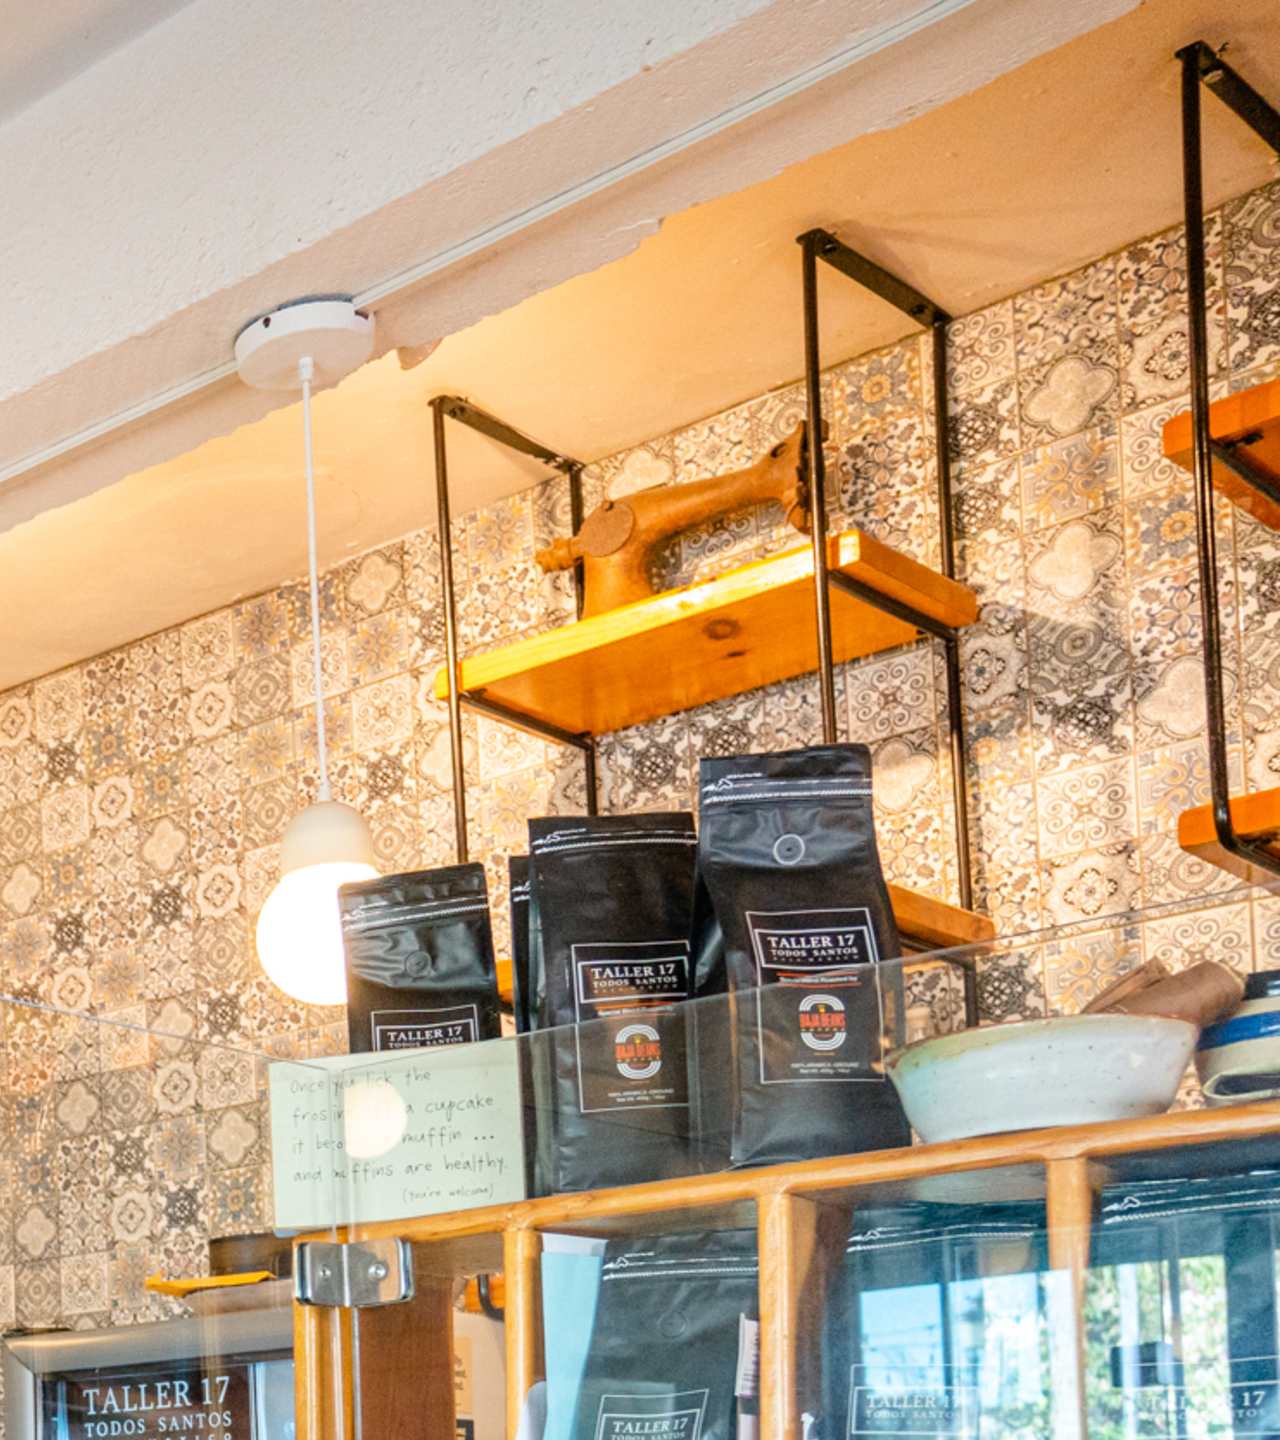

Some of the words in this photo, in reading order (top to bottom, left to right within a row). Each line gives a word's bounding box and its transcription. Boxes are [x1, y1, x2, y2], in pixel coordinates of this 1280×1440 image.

[767, 935, 833, 949] TALLER
[837, 933, 855, 947] 17
[771, 949, 807, 957] TODOS
[813, 946, 858, 957] SANTOS
[591, 965, 655, 979] TALLER
[659, 963, 676, 975] 17
[593, 979, 629, 989] TODOS
[635, 975, 678, 986] SANTOS
[387, 1030, 443, 1042] TALLER
[447, 1025, 462, 1037] 17
[290, 1079, 325, 1094] Once
[406, 1067, 431, 1085] the
[424, 1095, 494, 1121] cupcake
[293, 1164, 321, 1183] and
[405, 1163, 433, 1175] are
[82, 1380, 192, 1415] TALLER
[200, 1375, 230, 1406] 17
[867, 1395, 936, 1409] TALLER
[1241, 1390, 1266, 1407] 17
[84, 1418, 146, 1438] TODOS
[158, 1411, 232, 1432] SANTOS
[612, 1420, 670, 1434] TALLER
[673, 1417, 688, 1431] 17
[651, 1431, 685, 1440] SANTOS
